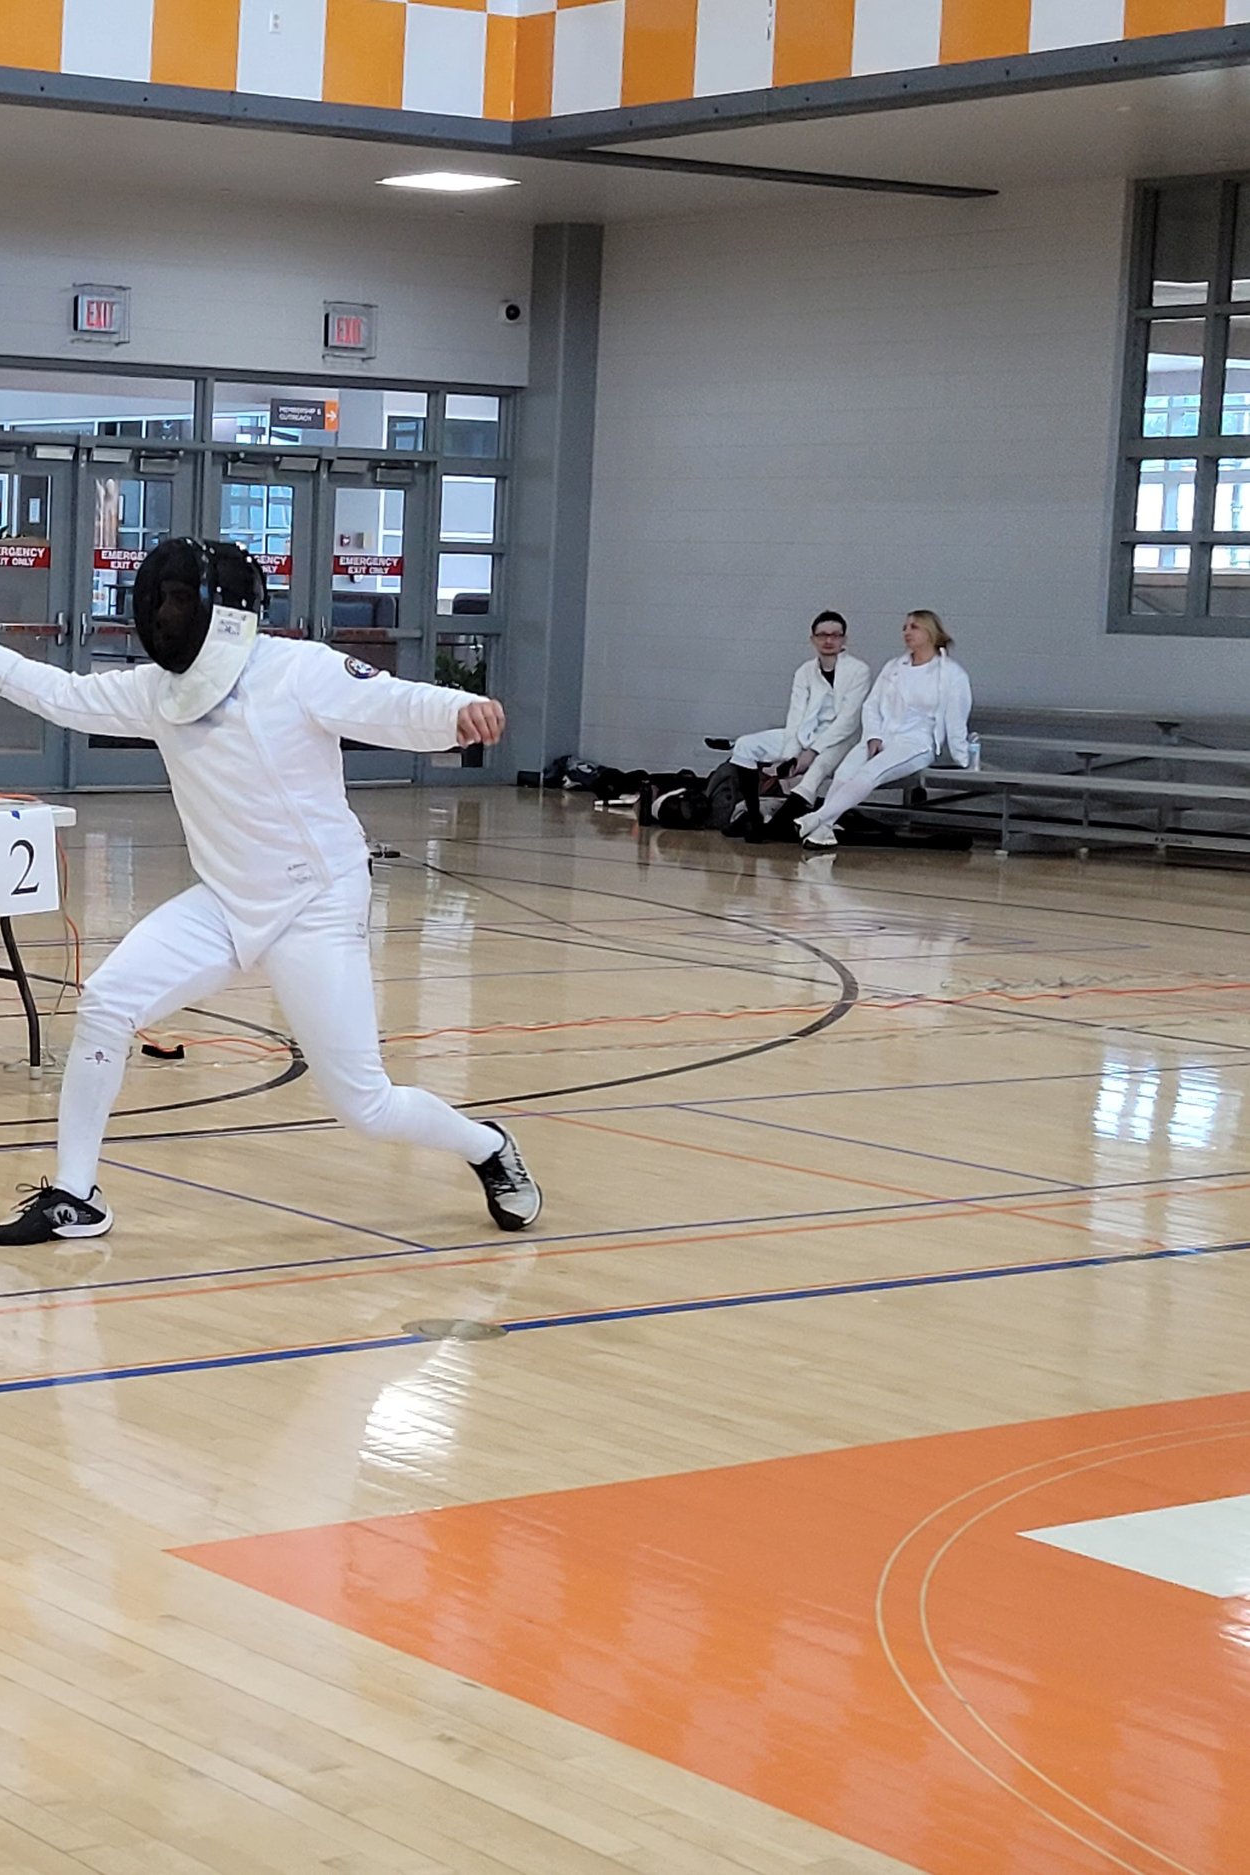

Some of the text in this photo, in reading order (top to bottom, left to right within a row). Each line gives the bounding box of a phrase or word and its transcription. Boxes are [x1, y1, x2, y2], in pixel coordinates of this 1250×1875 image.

[86, 300, 114, 328] EXIT
[337, 317, 362, 345] EXIT
[101, 550, 147, 561] EMERGE
[12, 557, 36, 567] ONLY
[110, 561, 132, 570] EXIT
[339, 556, 399, 567] EMERGENCY
[348, 566, 390, 575] EXIT ONLY
[10, 839, 40, 896] 2
